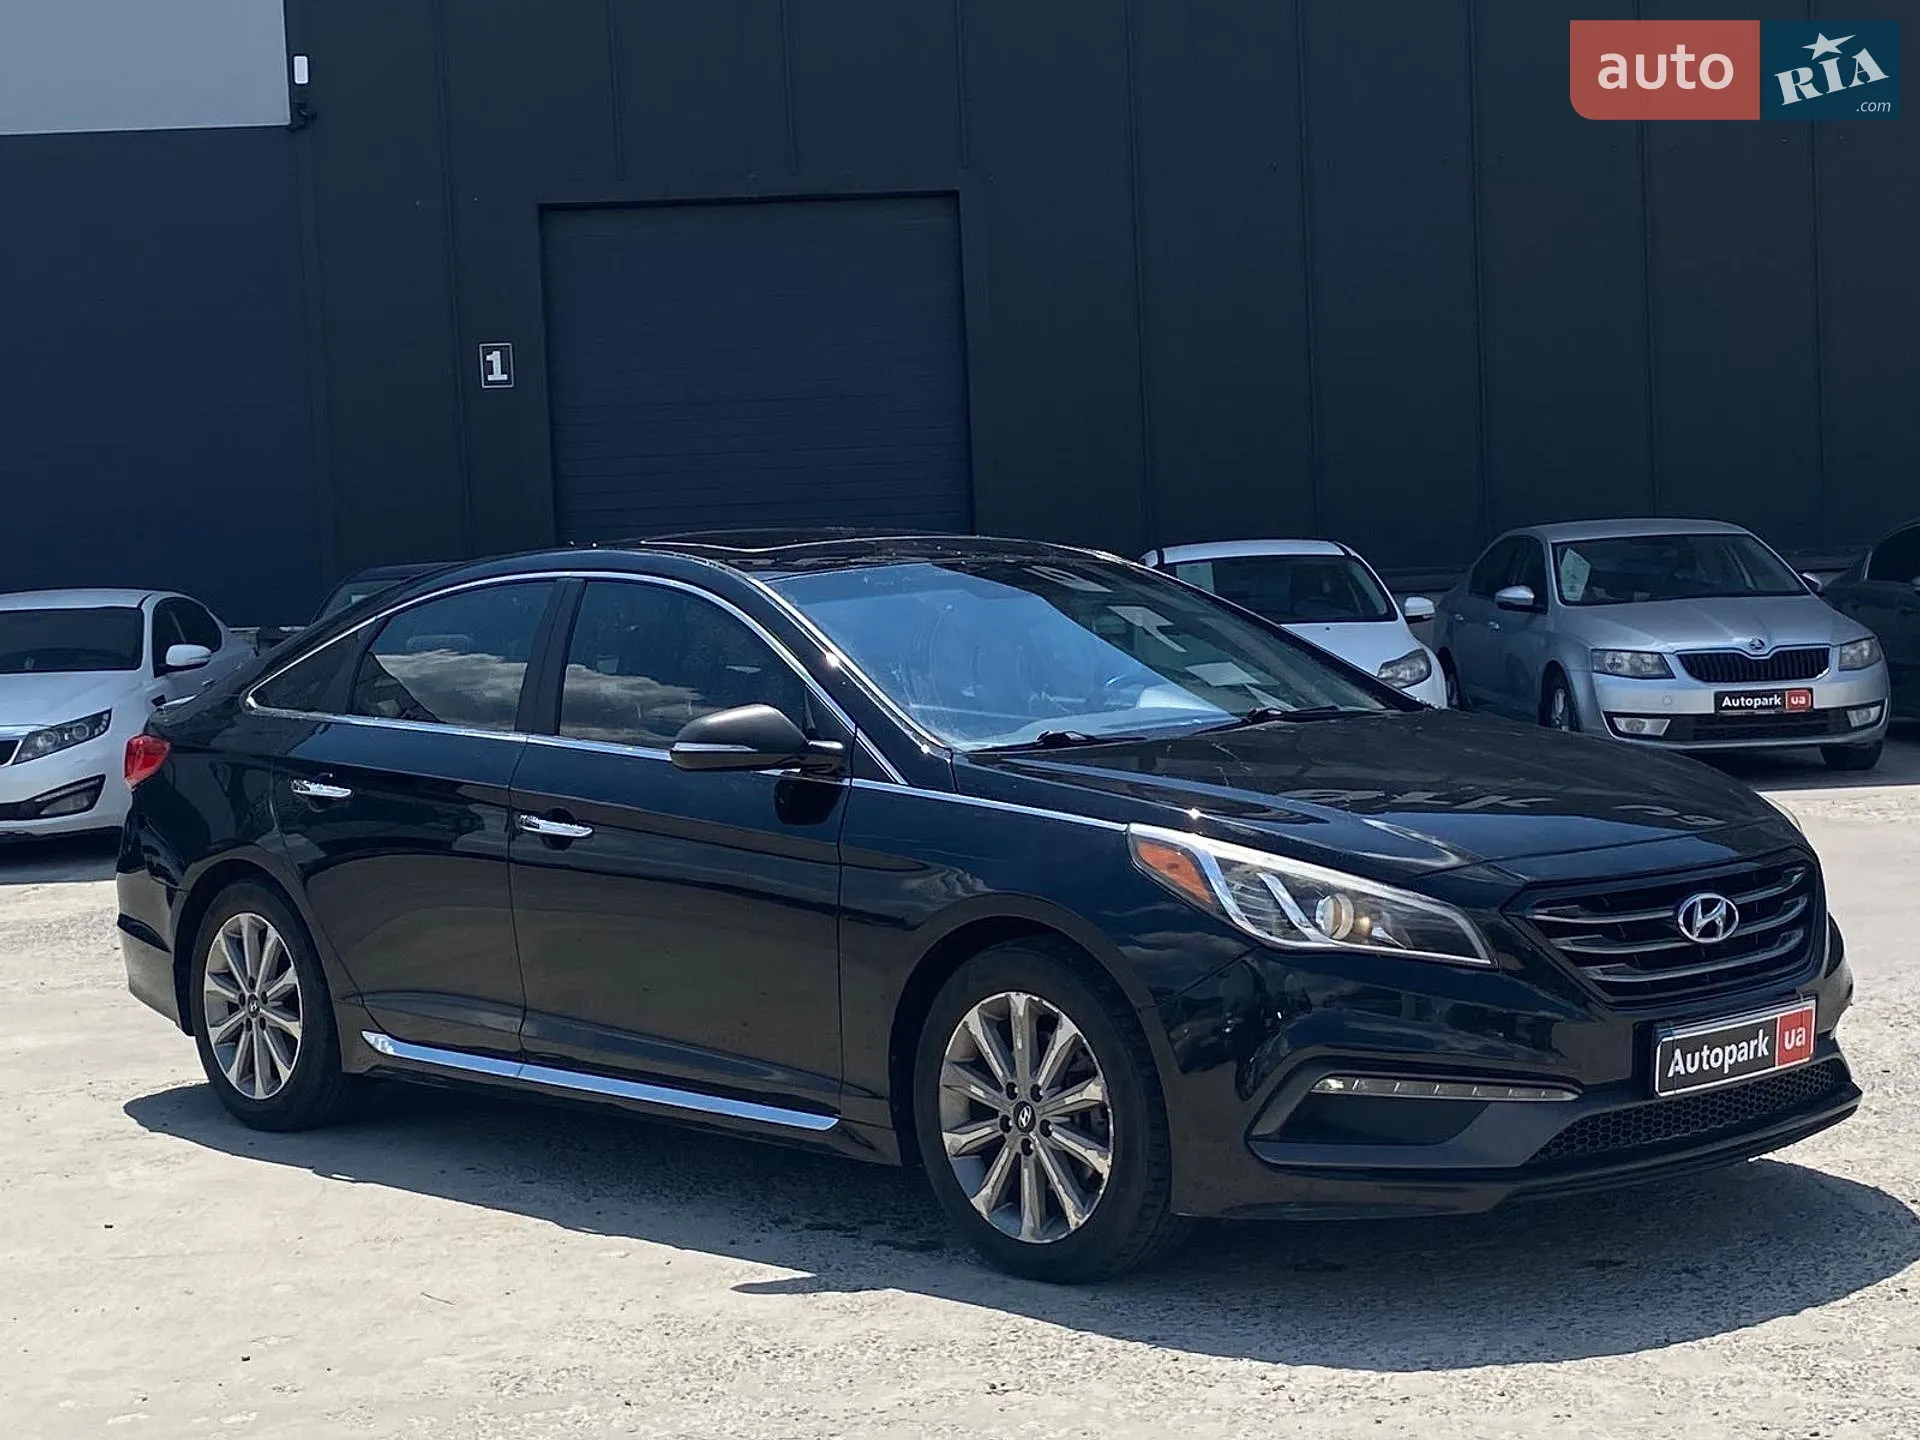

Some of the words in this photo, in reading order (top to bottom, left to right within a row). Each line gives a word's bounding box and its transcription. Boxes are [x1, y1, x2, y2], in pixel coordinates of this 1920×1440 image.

[486, 350, 508, 381] 1
[1721, 694, 1781, 708] Autopark
[1791, 695, 1806, 705] ua
[1667, 1029, 1769, 1078] Autopark
[1784, 1027, 1806, 1050] ua
